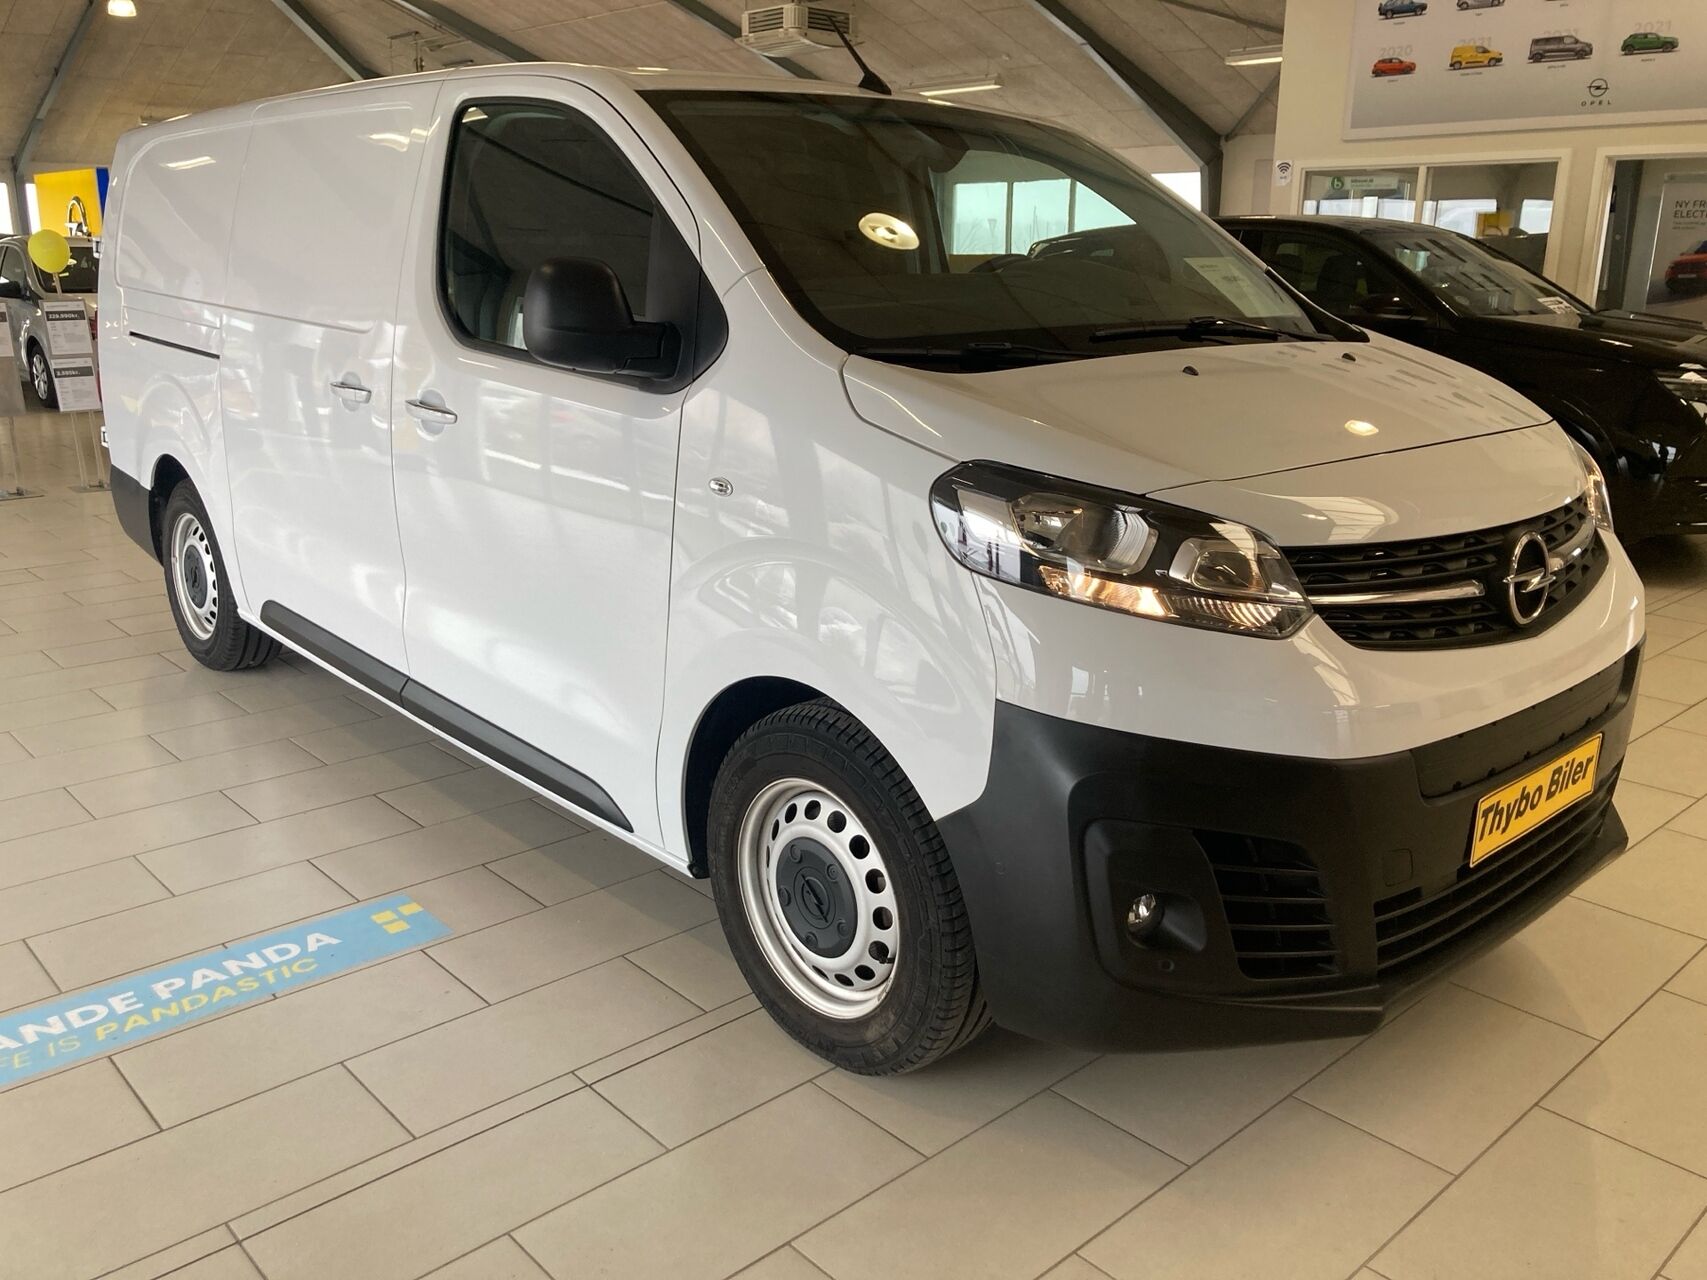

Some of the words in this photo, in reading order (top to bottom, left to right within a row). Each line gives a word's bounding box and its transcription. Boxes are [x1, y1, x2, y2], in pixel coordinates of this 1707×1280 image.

[1634, 20, 1672, 32] 2021
[1379, 45, 1413, 57] 2020
[1581, 98, 1612, 107] OPEL
[1675, 200, 1690, 208] NY
[1674, 209, 1707, 219] ELECT
[1479, 784, 1543, 842] Thybo
[1545, 755, 1595, 802] Biler
[151, 932, 342, 1000] PANDA
[48, 1035, 81, 1057] IS
[95, 957, 319, 1041] PANDASTIC
